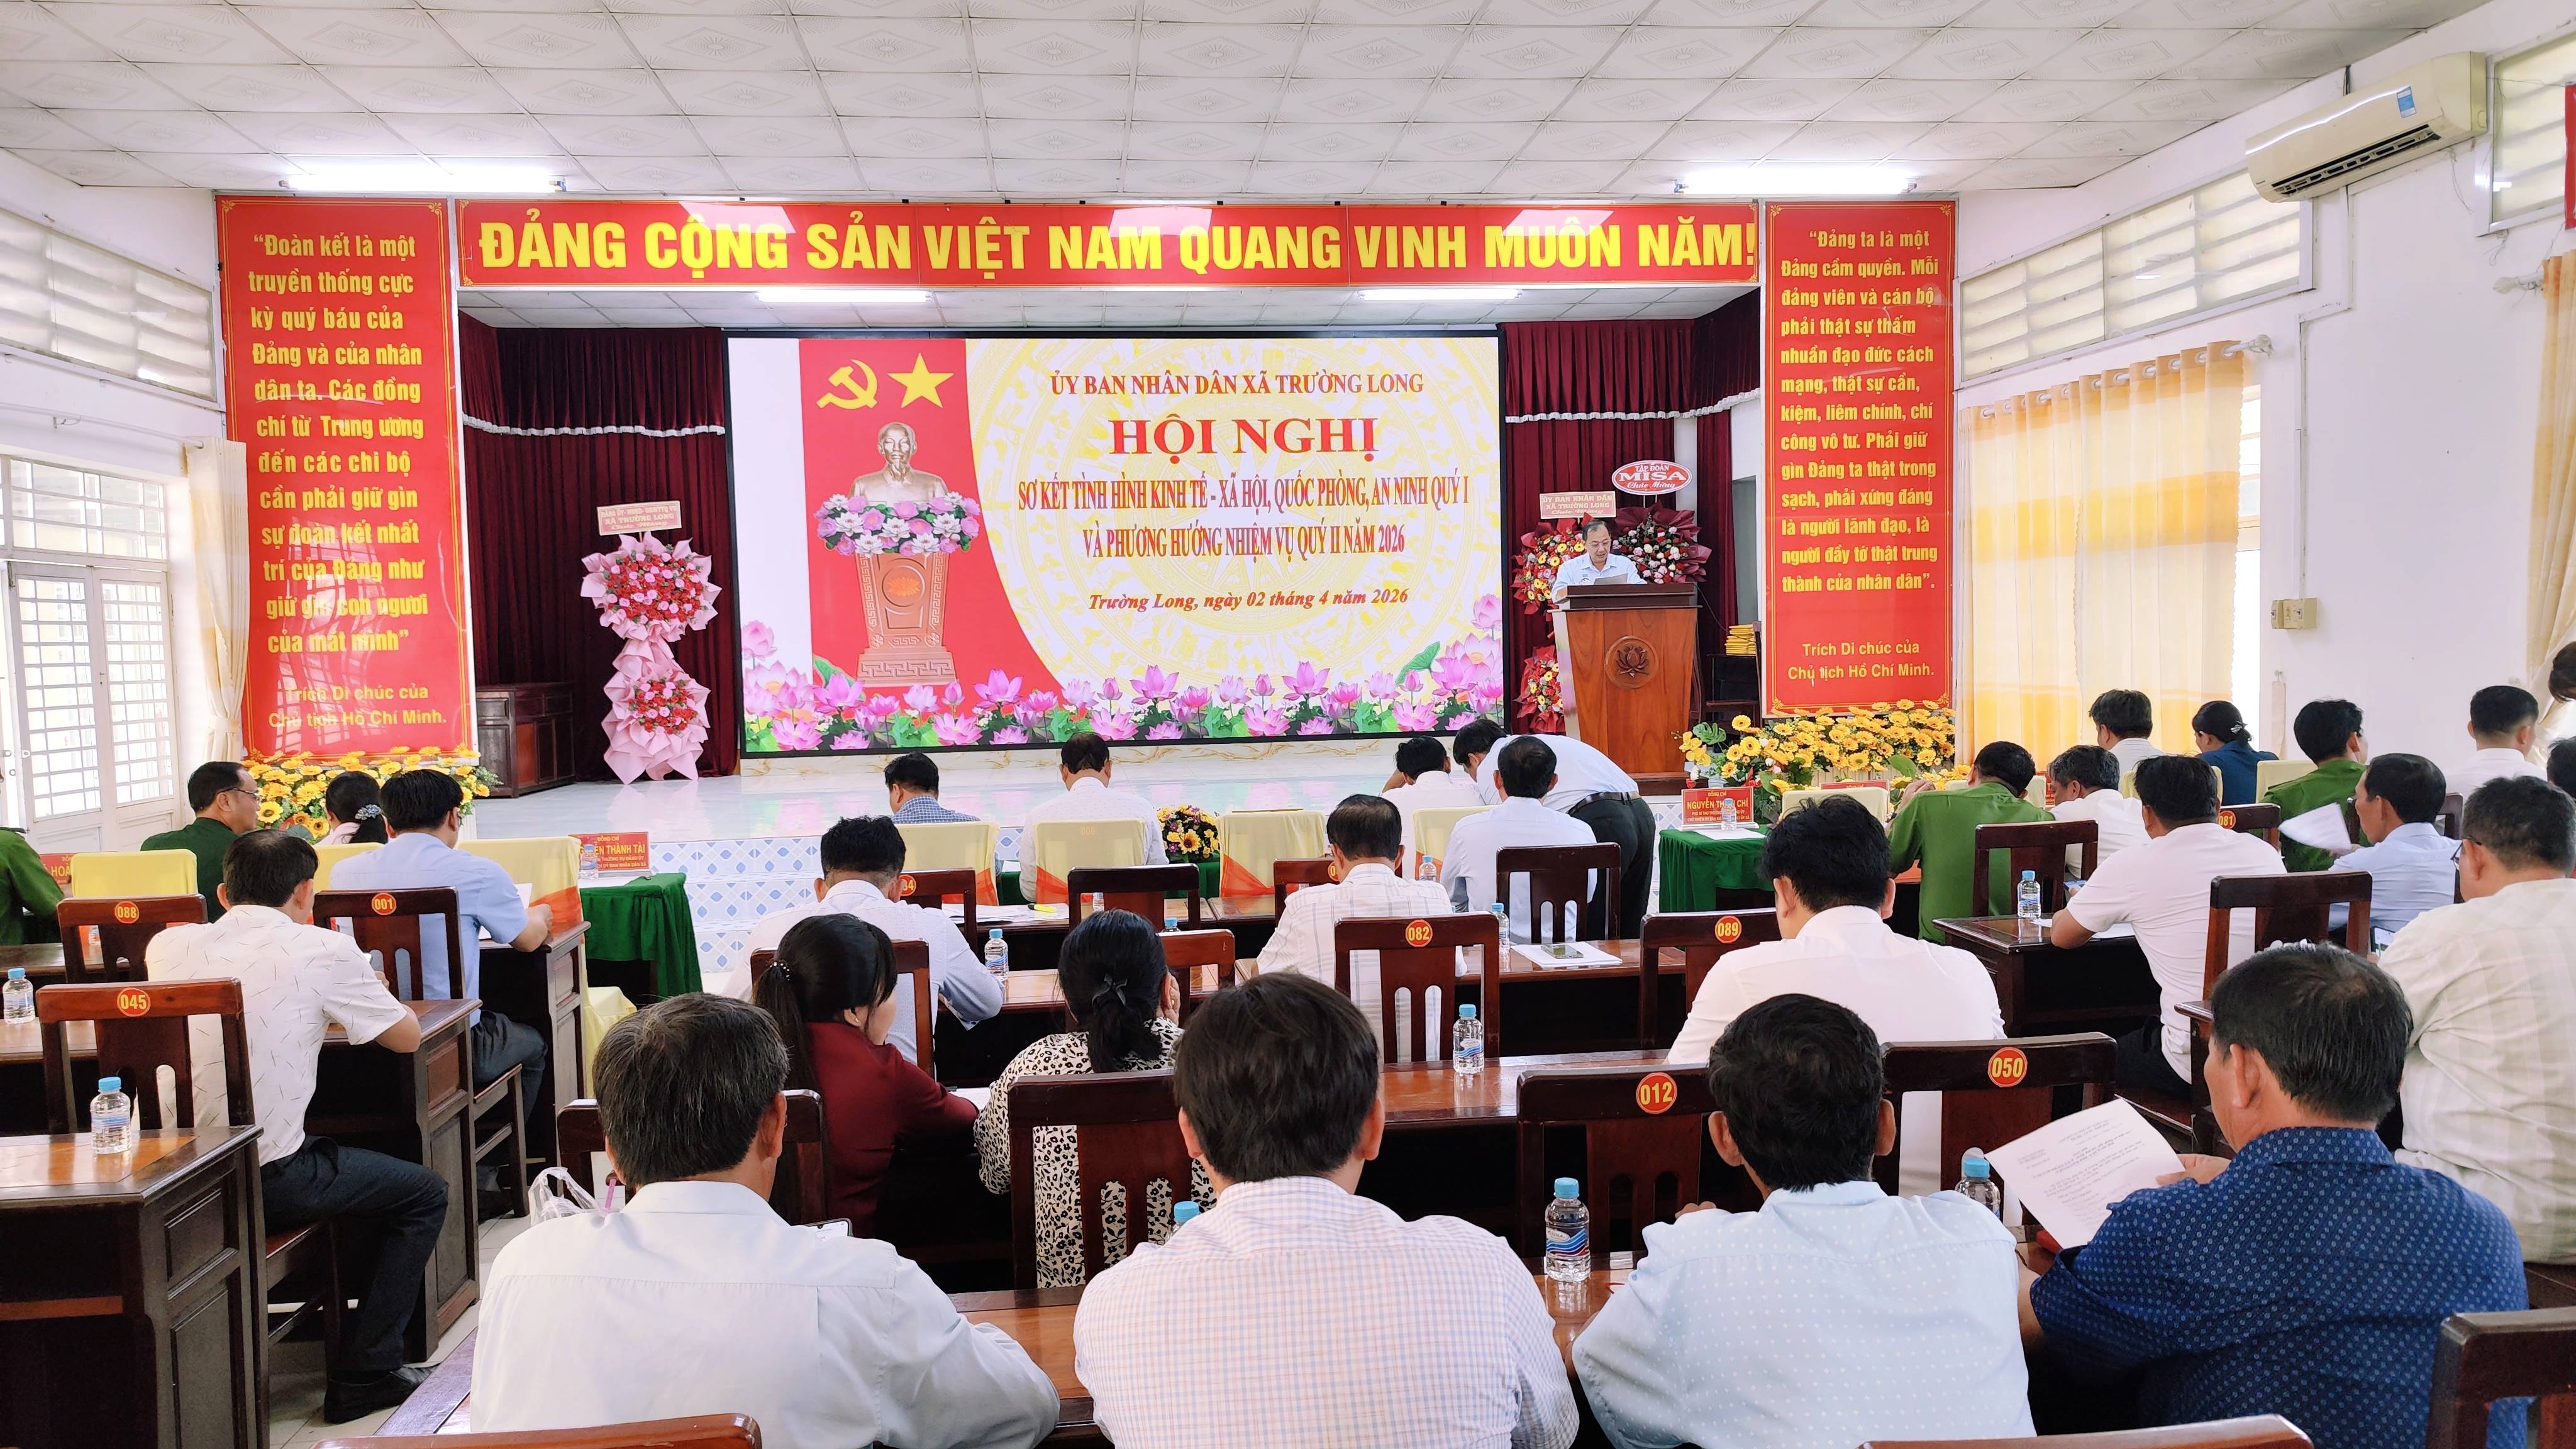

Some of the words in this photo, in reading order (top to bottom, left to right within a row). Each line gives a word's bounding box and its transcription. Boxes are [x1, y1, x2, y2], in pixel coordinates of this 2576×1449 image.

[255, 235, 313, 255] “Đoàn
[321, 233, 350, 256] kết
[356, 235, 372, 256] là
[380, 235, 415, 261] một
[479, 208, 626, 268] ĐẢNG
[645, 212, 794, 279] CỘNG
[807, 211, 911, 269] SẢN
[923, 217, 1030, 279] VIỆT
[1049, 222, 1164, 269] NAM
[1177, 222, 1340, 274] QUANG
[1354, 226, 1466, 267] VINH
[1485, 214, 1621, 268] MUÔN
[1638, 214, 1757, 269] NĂM!
[1810, 229, 1855, 248] “Đảng
[1861, 232, 1874, 247] ta
[1880, 231, 1893, 247] là
[1901, 231, 1928, 249] một
[1781, 258, 1817, 278] Đảng
[1823, 258, 1853, 276] cầm
[1858, 258, 1905, 277] quyền.
[1911, 255, 1938, 275] Mỗi
[249, 269, 311, 294] truyền
[318, 269, 372, 295] thống
[379, 274, 413, 297] cực
[1782, 287, 1818, 307] đảng
[1823, 289, 1855, 305] viên
[1860, 289, 1877, 304] và
[1883, 288, 1911, 304] cán
[1916, 287, 1933, 307] bộ
[252, 306, 273, 330] kỳ
[282, 307, 316, 331] quý
[324, 307, 360, 328] báu
[367, 305, 402, 329] của
[1781, 316, 1814, 336] phải
[1820, 318, 1850, 337] thật
[1855, 319, 1874, 337] sự
[1877, 313, 1915, 334] thấm
[252, 341, 301, 367] Đảng
[307, 343, 328, 364] và
[335, 341, 369, 365] của
[376, 343, 421, 365] nhân
[1781, 345, 1827, 364] nhuần
[1833, 347, 1860, 366] đạo
[1865, 346, 1892, 362] đức
[1897, 346, 1933, 362] cách
[255, 379, 291, 401] dân
[297, 380, 322, 400] ta.
[329, 379, 366, 401] Các
[372, 377, 421, 403] đồng
[1050, 370, 1078, 394] ỦY
[1084, 375, 1126, 394] BAN
[1131, 370, 1189, 394] NHÂN
[1195, 370, 1236, 394] DÂN
[1242, 370, 1271, 394] XÃ
[1275, 369, 1362, 393] TRƯỜNG
[1367, 373, 1424, 392] LONG
[1108, 413, 1218, 464] HỘI
[1232, 418, 1379, 462] NGHỊ
[1619, 472, 1687, 482] MISA
[1018, 479, 1037, 510] SƠ
[1040, 472, 1069, 509] KẾT
[1072, 472, 1108, 509] TÌNH
[1111, 472, 1147, 509] HÌNH
[1150, 480, 1187, 508] KINH
[1190, 471, 1208, 508] TẾ
[1219, 472, 1238, 508] XÃ
[1241, 474, 1270, 514] HỘI,
[1274, 470, 1314, 514] QUỐC
[1318, 469, 1369, 512] PHÒNG,
[1371, 478, 1392, 506] AN
[1394, 477, 1428, 504] NINH
[1431, 468, 1461, 511] QUÝ
[1463, 476, 1468, 504] I
[1083, 521, 1102, 558] VÀ
[1106, 524, 1167, 557] PHƯƠNG
[1170, 519, 1223, 557] HƯỚNG
[1225, 523, 1272, 563] NHIỆM
[1275, 526, 1294, 562] VỤ
[1297, 518, 1327, 561] QUÝ
[1330, 525, 1340, 553] II
[1343, 518, 1375, 553] NĂM
[1378, 524, 1405, 552] 2026
[1782, 575, 1822, 592] thành
[1827, 573, 1852, 591] của
[1857, 574, 1891, 590] nhân
[1896, 573, 1934, 589] dân”.
[1089, 594, 1150, 612] Trường
[1152, 593, 1198, 611] Long,
[1204, 592, 1242, 611] ngày
[1246, 591, 1265, 606] 02
[1270, 591, 1315, 609] tháng
[1319, 591, 1328, 605] 4
[1333, 590, 1365, 604] năm
[1371, 588, 1409, 604] 2026
[1802, 643, 1836, 656] Trích
[1841, 642, 1854, 655] Di
[1859, 641, 1891, 654] chúc
[1896, 640, 1919, 653] của
[1788, 665, 1814, 683] Chủ
[1819, 665, 1843, 680] tịch
[1849, 663, 1867, 677] Hồ
[1872, 664, 1894, 677] Chí
[1899, 663, 1933, 675] Minh.
[286, 684, 326, 701] Trích
[332, 684, 348, 700] Di
[355, 683, 394, 699] chúc
[399, 682, 428, 699] của
[268, 709, 301, 728] Chủ
[306, 711, 336, 729] tịch
[342, 709, 364, 726] Hồ
[370, 709, 397, 725] Chí
[402, 708, 447, 724] Minh.
[1687, 797, 1714, 809] NGUYỄN
[1737, 797, 1748, 807] CHÍ
[2218, 815, 2233, 826] 081
[606, 843, 631, 854] THÀNH
[633, 842, 645, 853] TÀI
[116, 907, 137, 919] 088
[375, 899, 394, 911] 001
[1407, 926, 1430, 940] 082
[1718, 923, 1739, 936] 089
[119, 995, 147, 1010] 045
[1991, 1055, 2024, 1080] 050
[1640, 1082, 1674, 1106] 012
